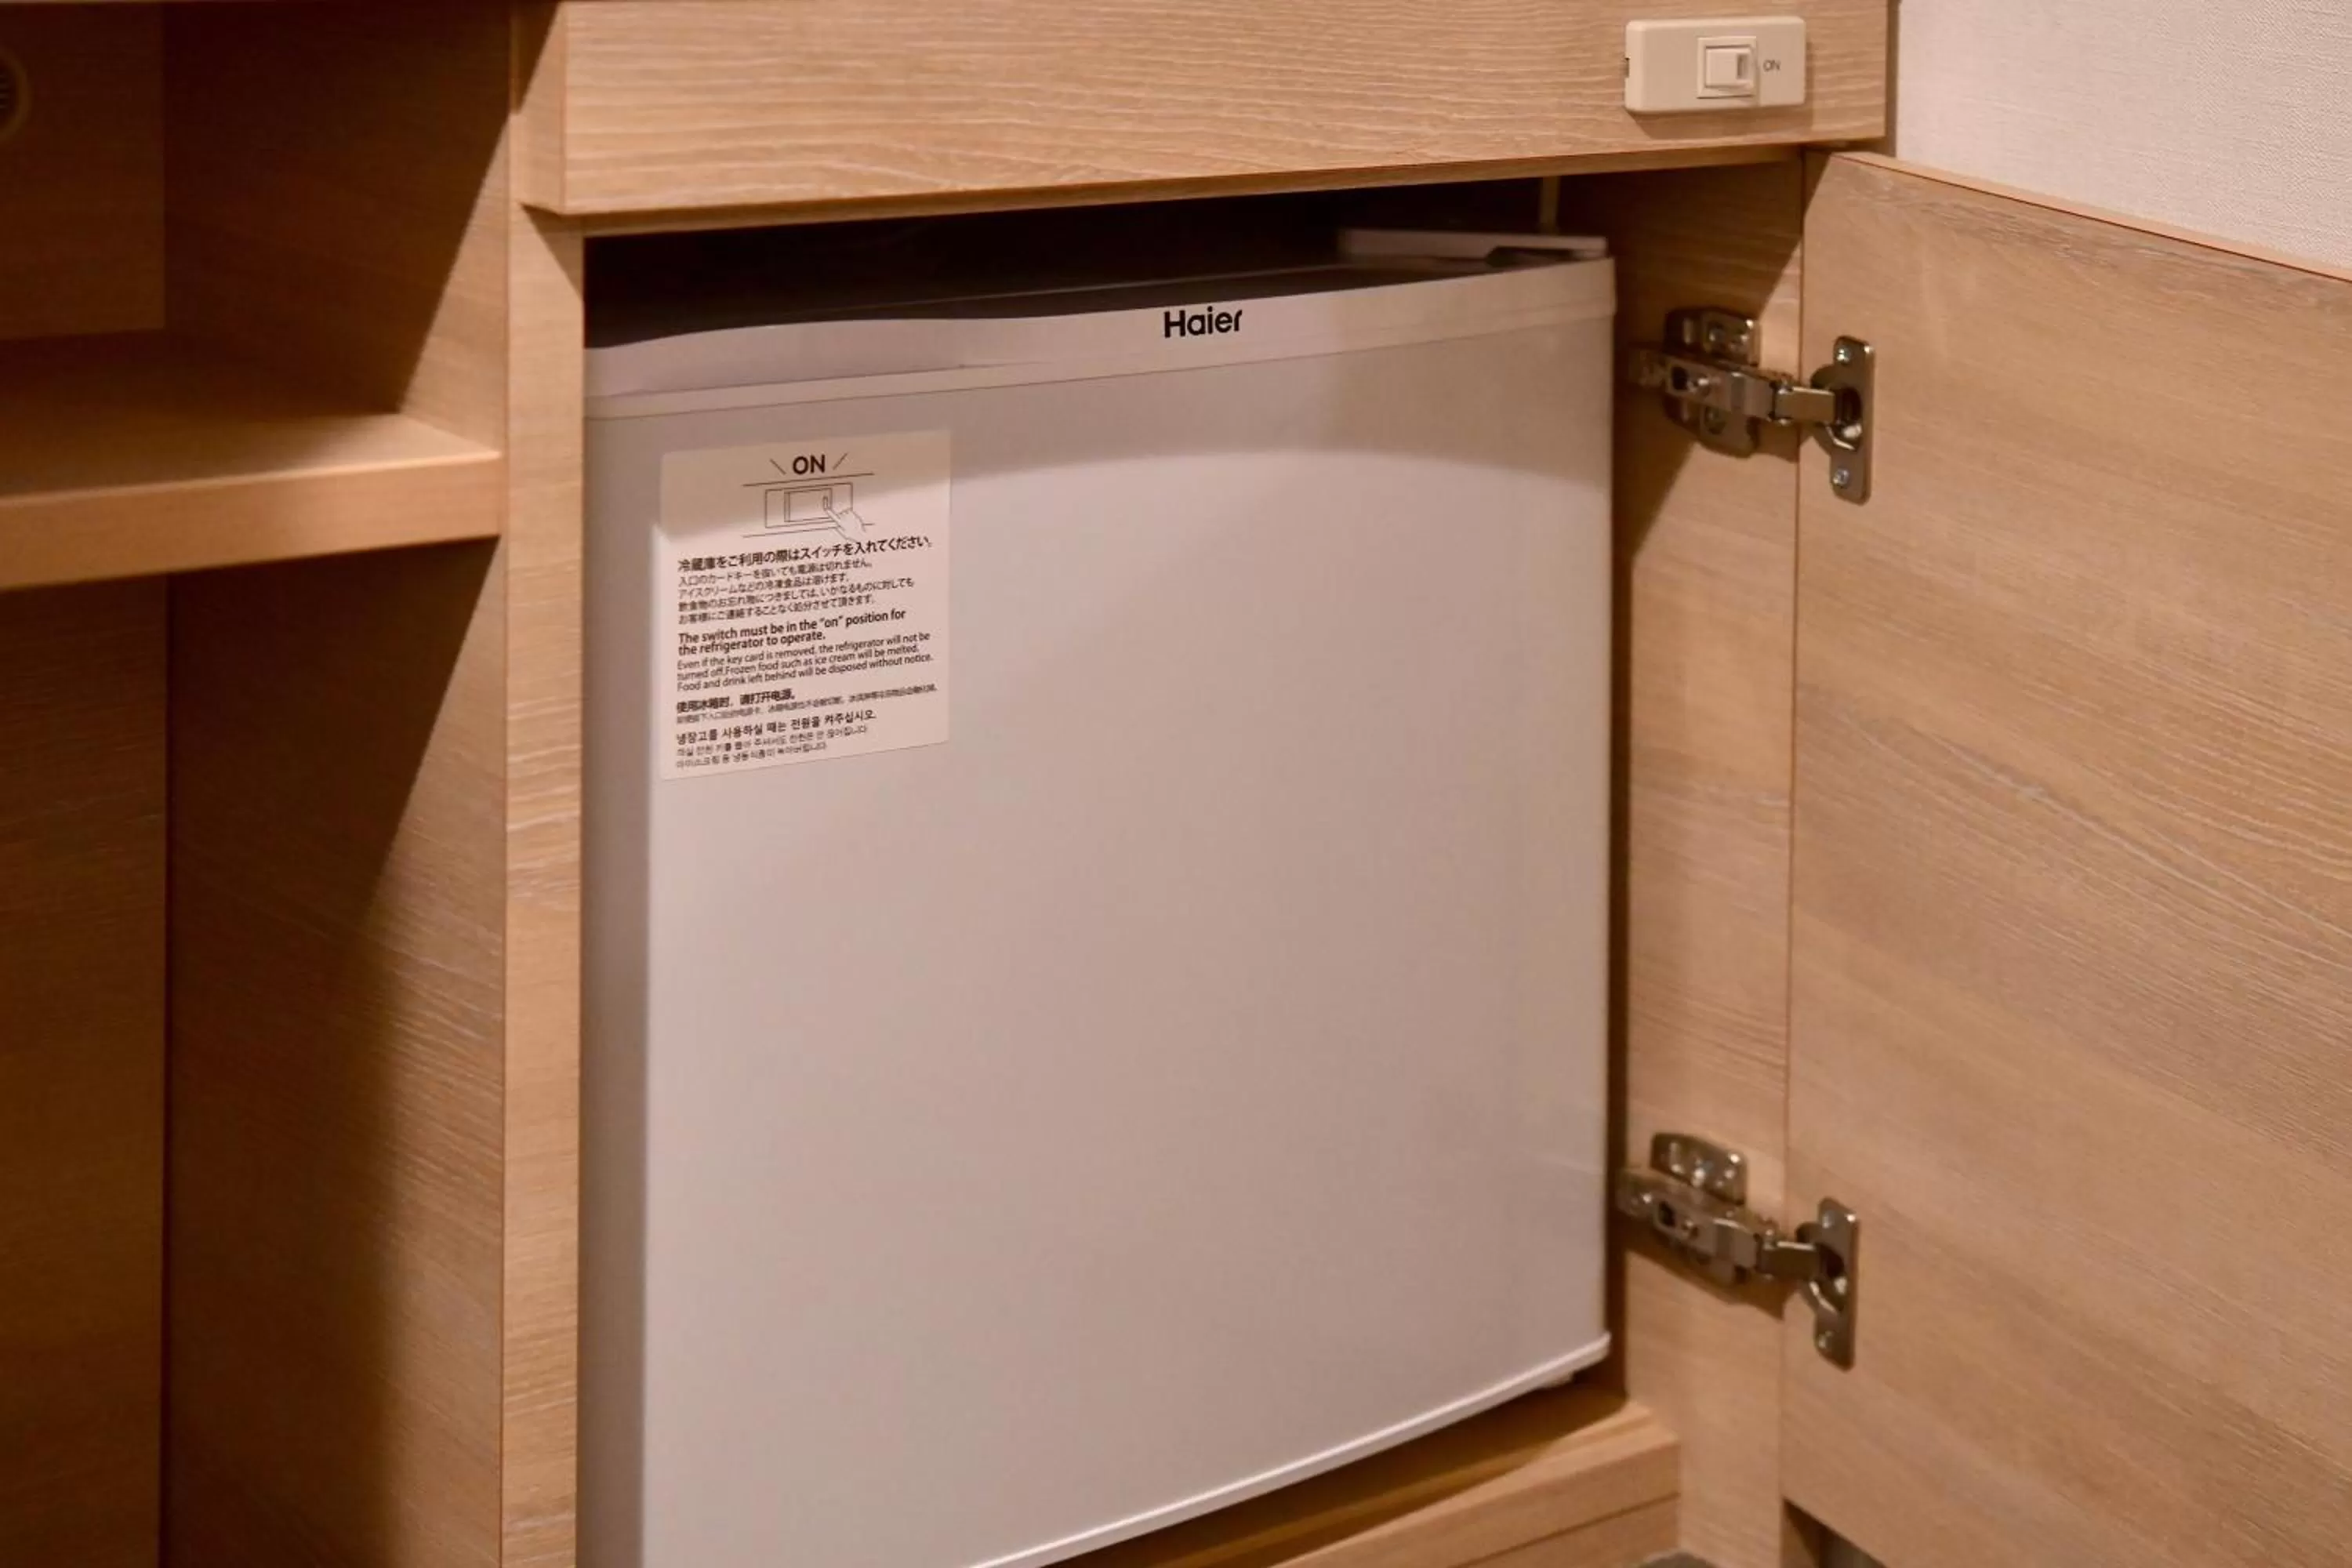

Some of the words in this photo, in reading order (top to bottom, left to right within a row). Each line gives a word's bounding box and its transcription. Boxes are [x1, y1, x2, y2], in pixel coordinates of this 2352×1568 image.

[1763, 60, 1780, 72] ON
[1163, 306, 1243, 338] Haier
[793, 454, 826, 475] ON
[678, 633, 699, 644] The
[702, 627, 738, 641] switch
[740, 625, 768, 637] must
[770, 623, 784, 633] be
[786, 621, 797, 632] in
[799, 619, 817, 630] the
[846, 612, 888, 627] position
[891, 608, 906, 619] for
[677, 660, 700, 670] Even
[702, 657, 710, 667] if
[710, 657, 725, 666] the
[726, 655, 742, 666] key
[744, 651, 764, 662] card
[766, 651, 773, 660] is
[818, 644, 833, 653] the
[835, 640, 884, 652] refrigerator
[886, 635, 901, 644] will
[902, 634, 917, 643] not
[919, 633, 930, 641] be
[679, 644, 697, 655] the
[699, 638, 764, 654] refrigerator
[766, 637, 778, 646] to
[780, 631, 826, 646] operate.
[677, 669, 709, 681] turned
[758, 660, 779, 671] food
[781, 659, 801, 669] such
[815, 655, 827, 665] ice
[829, 653, 856, 662] cream
[858, 649, 872, 659] will
[874, 648, 885, 657] be
[677, 681, 701, 691] Food
[703, 677, 721, 688] and
[722, 676, 746, 687] drink
[748, 673, 763, 684] left
[764, 670, 797, 682] behind
[798, 666, 813, 677] will
[828, 660, 867, 674] disposed
[869, 657, 902, 669] without
[904, 654, 933, 664] notice.
